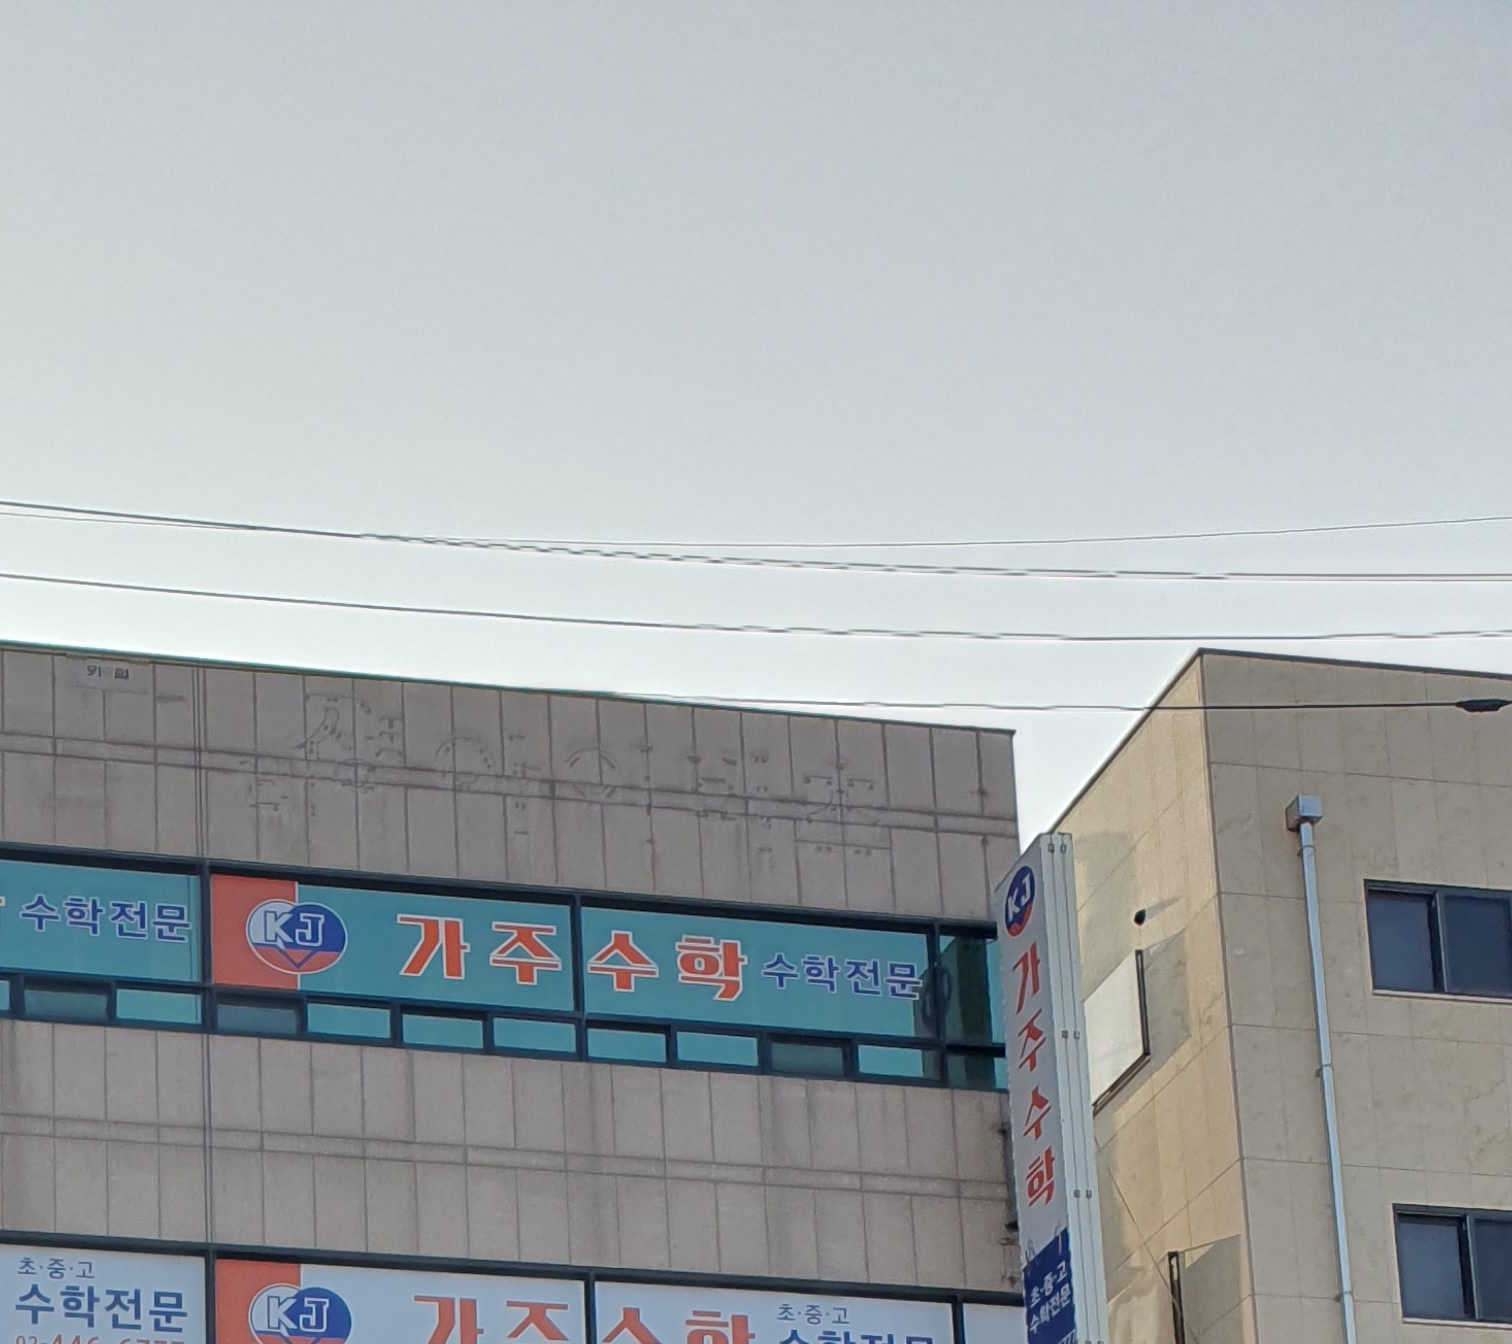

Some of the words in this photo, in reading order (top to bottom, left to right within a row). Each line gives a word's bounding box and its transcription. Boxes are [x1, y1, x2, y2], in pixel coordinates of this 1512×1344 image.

[20, 892, 193, 945] 수학전문
[259, 909, 325, 950] KJ
[395, 913, 749, 1003] 가주수학
[762, 952, 924, 1001] 수학전문
[1011, 941, 1056, 1208] 가주수학
[14, 1284, 190, 1335] 수학전문
[265, 1290, 331, 1334] KJ
